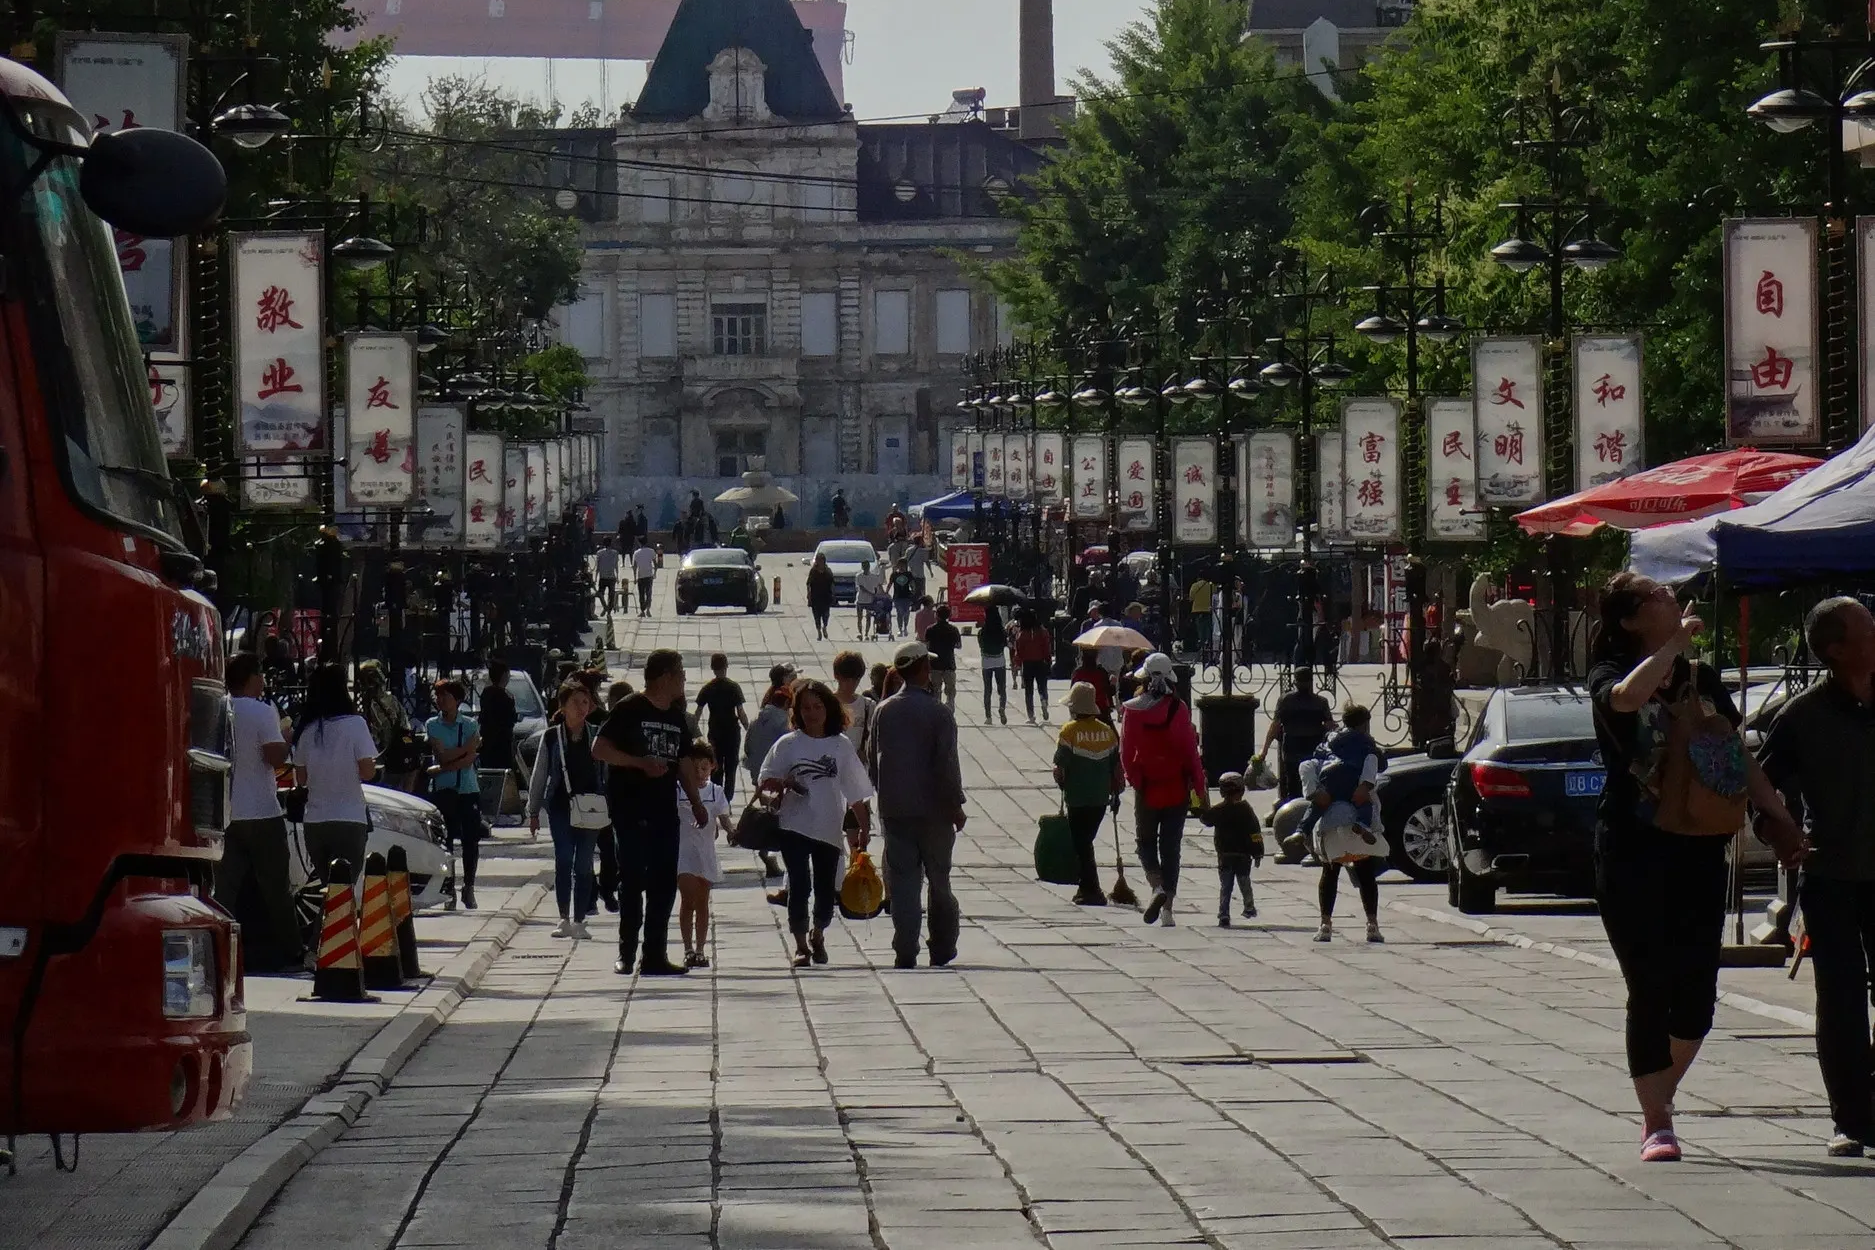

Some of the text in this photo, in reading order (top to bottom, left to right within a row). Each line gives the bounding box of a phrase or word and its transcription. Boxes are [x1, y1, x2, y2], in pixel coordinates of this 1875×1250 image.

[257, 285, 304, 400] 敬业
[1750, 269, 1793, 391] 自由
[364, 376, 400, 464] 友善
[1489, 376, 1525, 466] 文明
[1592, 373, 1627, 465] 和谐
[469, 459, 492, 523] 民主
[1010, 449, 1022, 484] 文明
[1042, 449, 1056, 488] 自由
[1080, 456, 1097, 498] 公正
[1127, 460, 1145, 508] 爱国
[1184, 464, 1206, 517] 诚信
[1357, 431, 1385, 507] 富强
[1443, 430, 1471, 506] 民主
